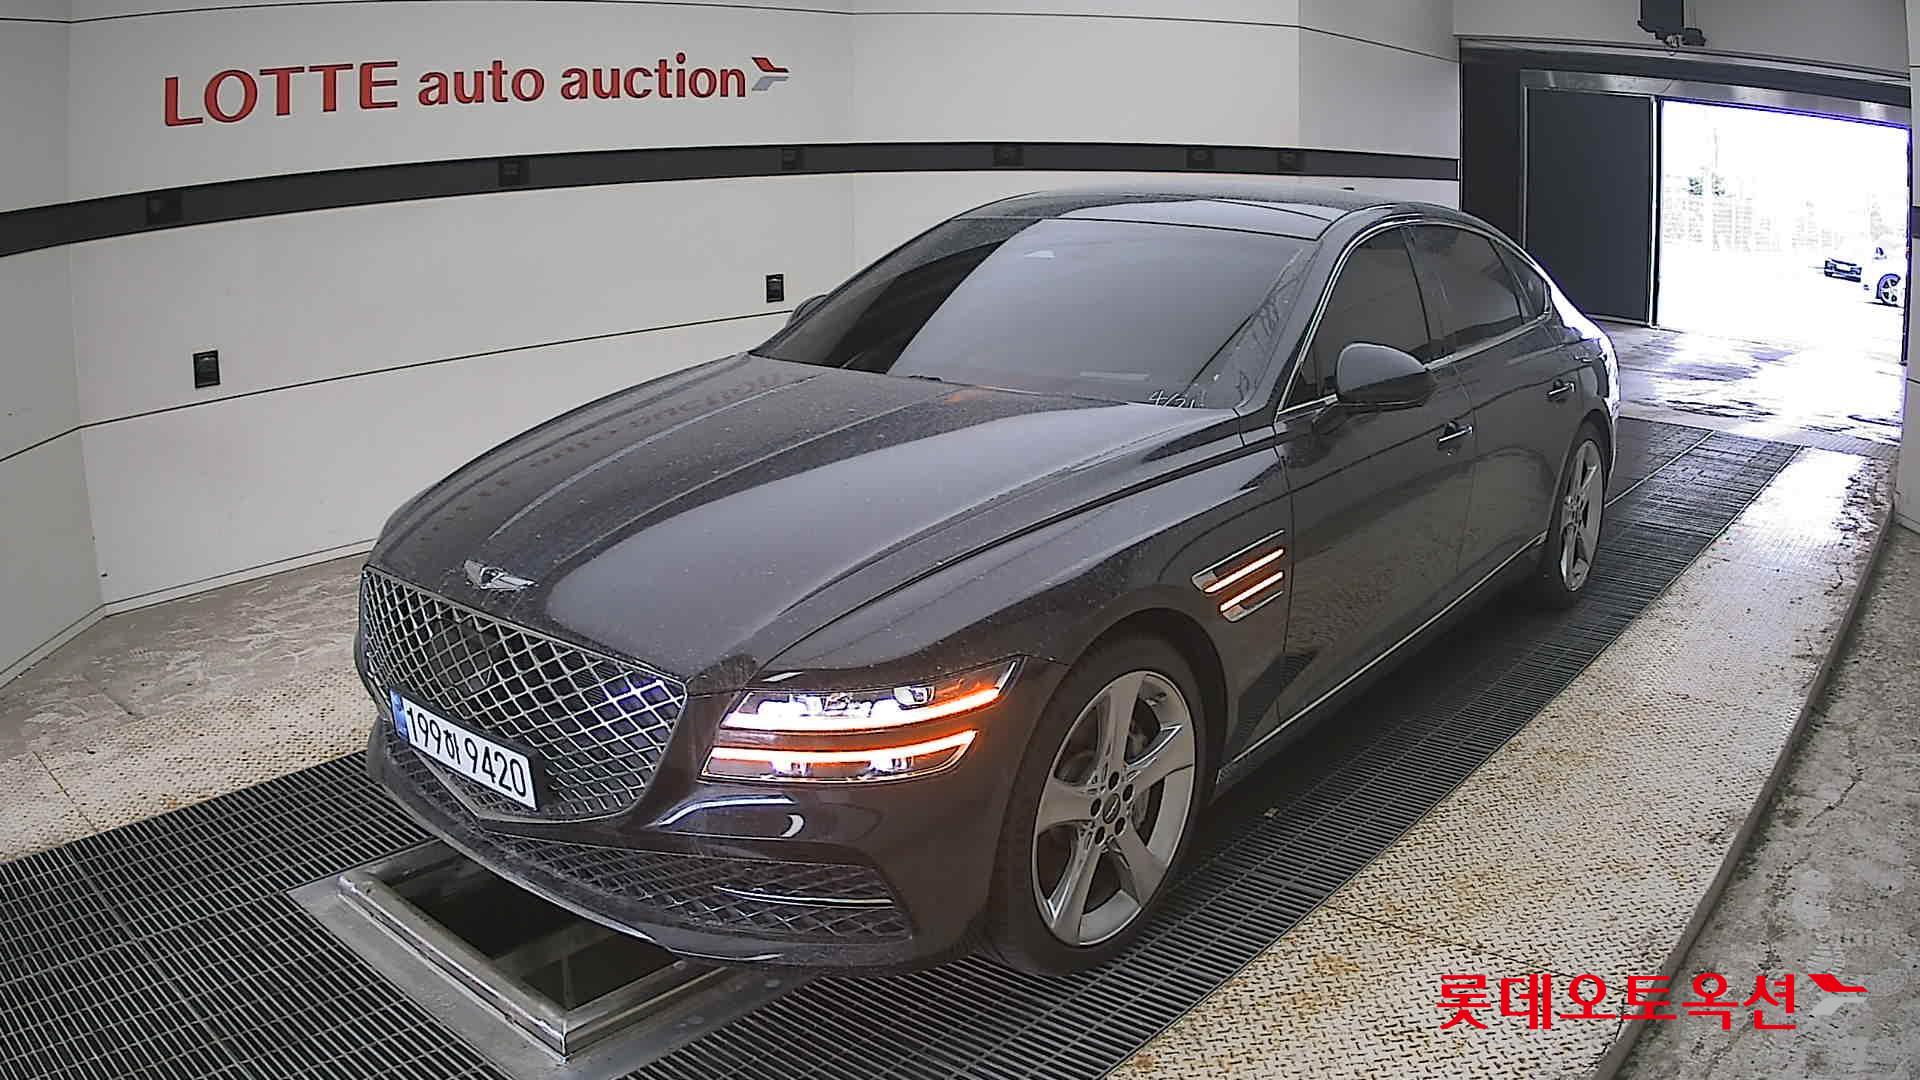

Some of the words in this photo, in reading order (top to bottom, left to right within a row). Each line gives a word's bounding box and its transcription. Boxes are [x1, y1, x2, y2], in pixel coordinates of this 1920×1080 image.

[164, 60, 398, 127] LOTTE
[418, 60, 545, 106] auto
[560, 53, 748, 99] auction
[464, 737, 527, 797] 9420
